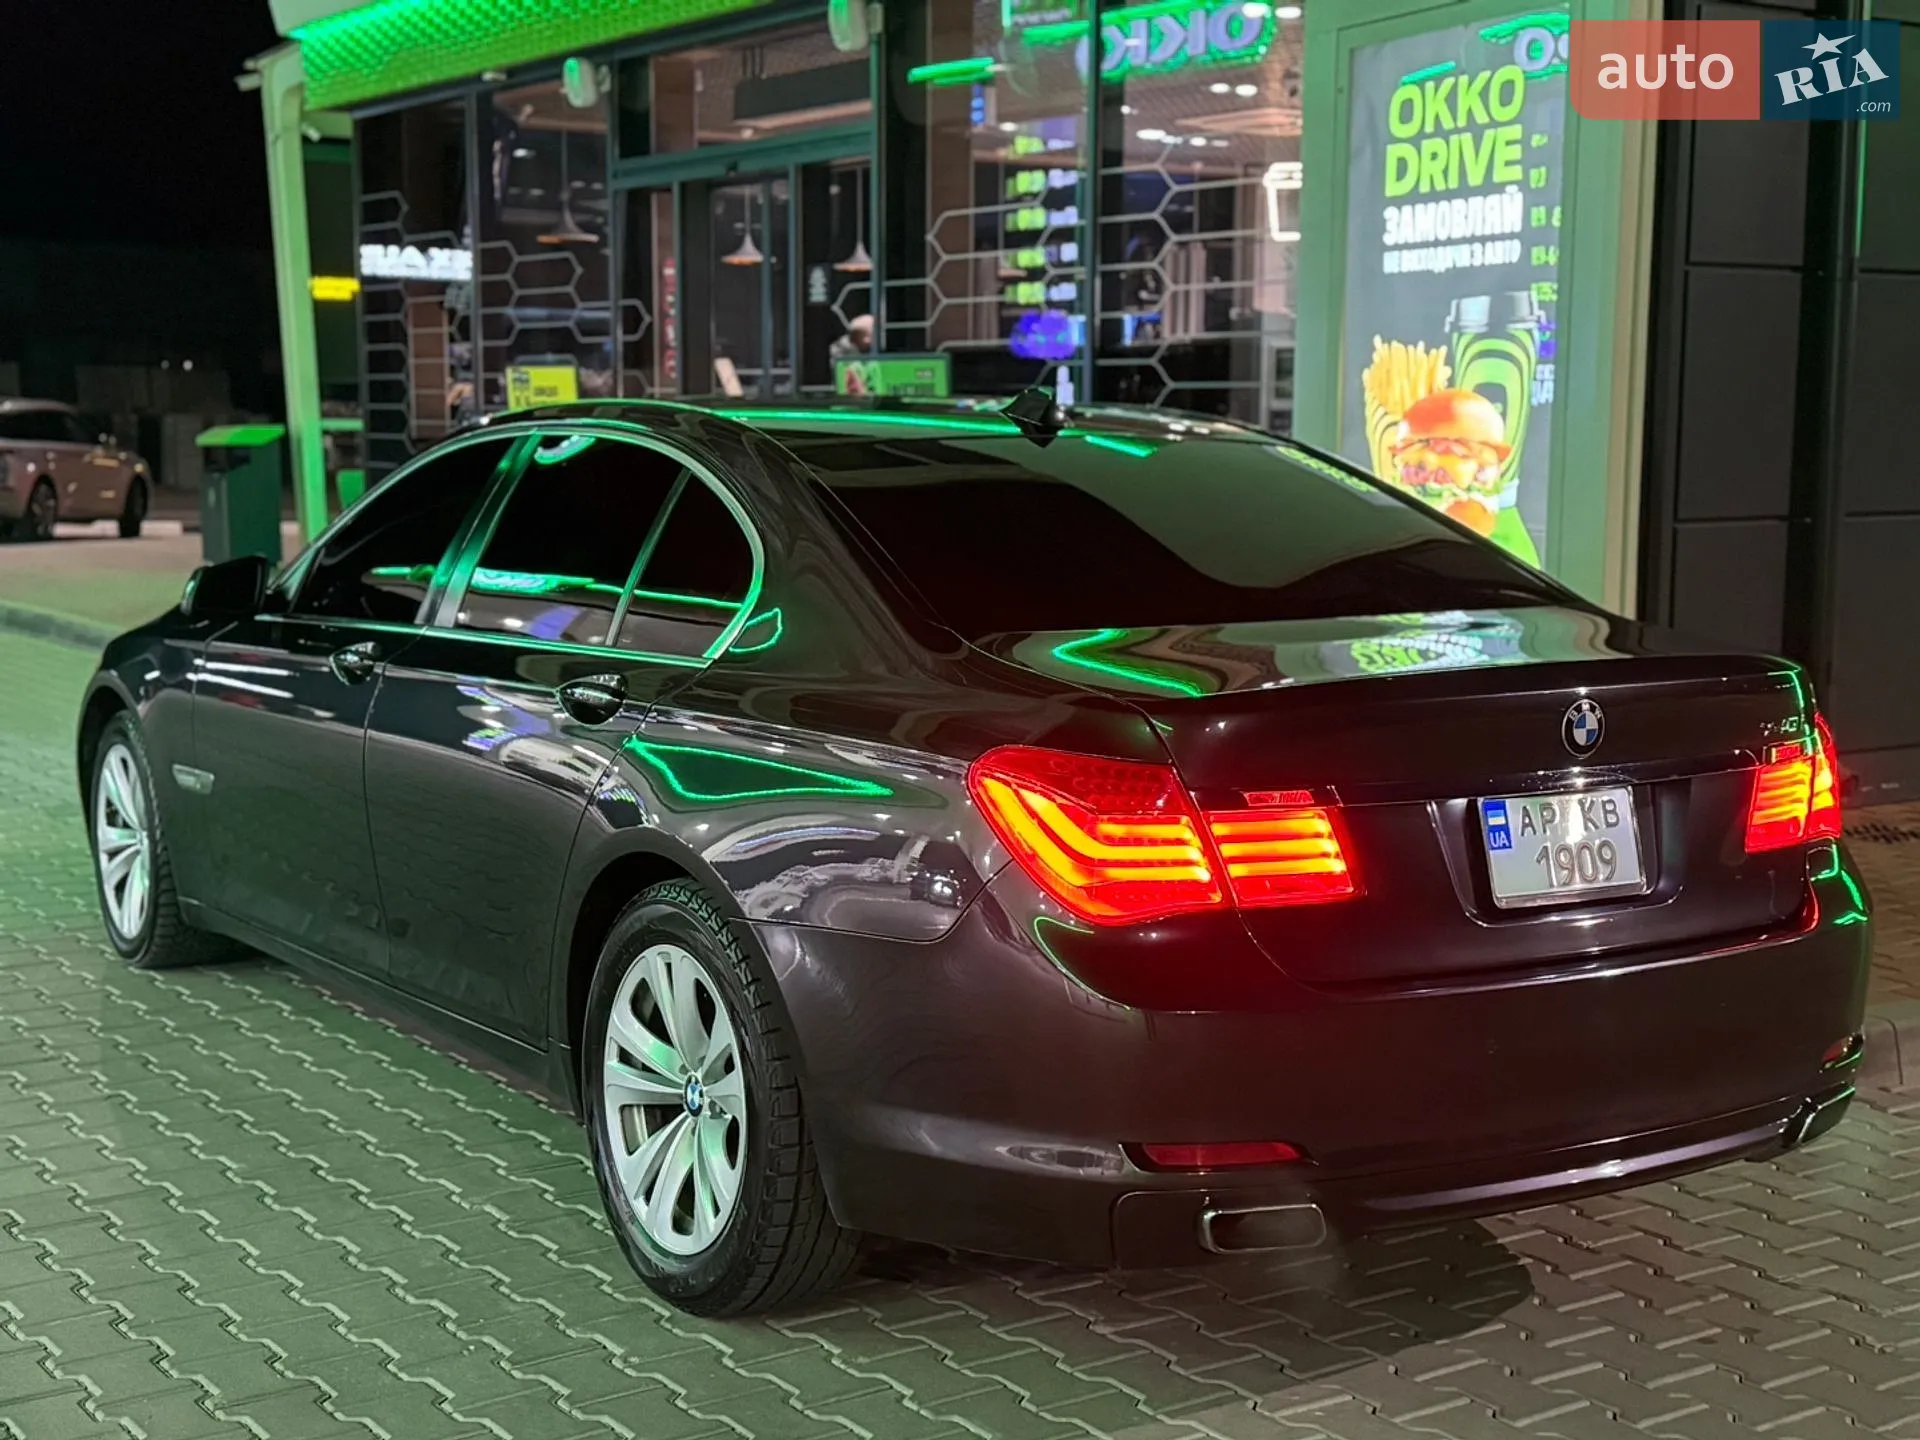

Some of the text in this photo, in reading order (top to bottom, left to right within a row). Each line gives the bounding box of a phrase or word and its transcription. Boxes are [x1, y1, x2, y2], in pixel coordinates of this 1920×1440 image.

[1388, 64, 1525, 139] OKKO
[1384, 123, 1523, 198] DRIVE
[1382, 184, 1524, 246] ЗАМОВЛЯЙ
[1489, 830, 1510, 849] UA
[1520, 797, 1619, 837] AP KB
[1535, 838, 1618, 889] 1909
